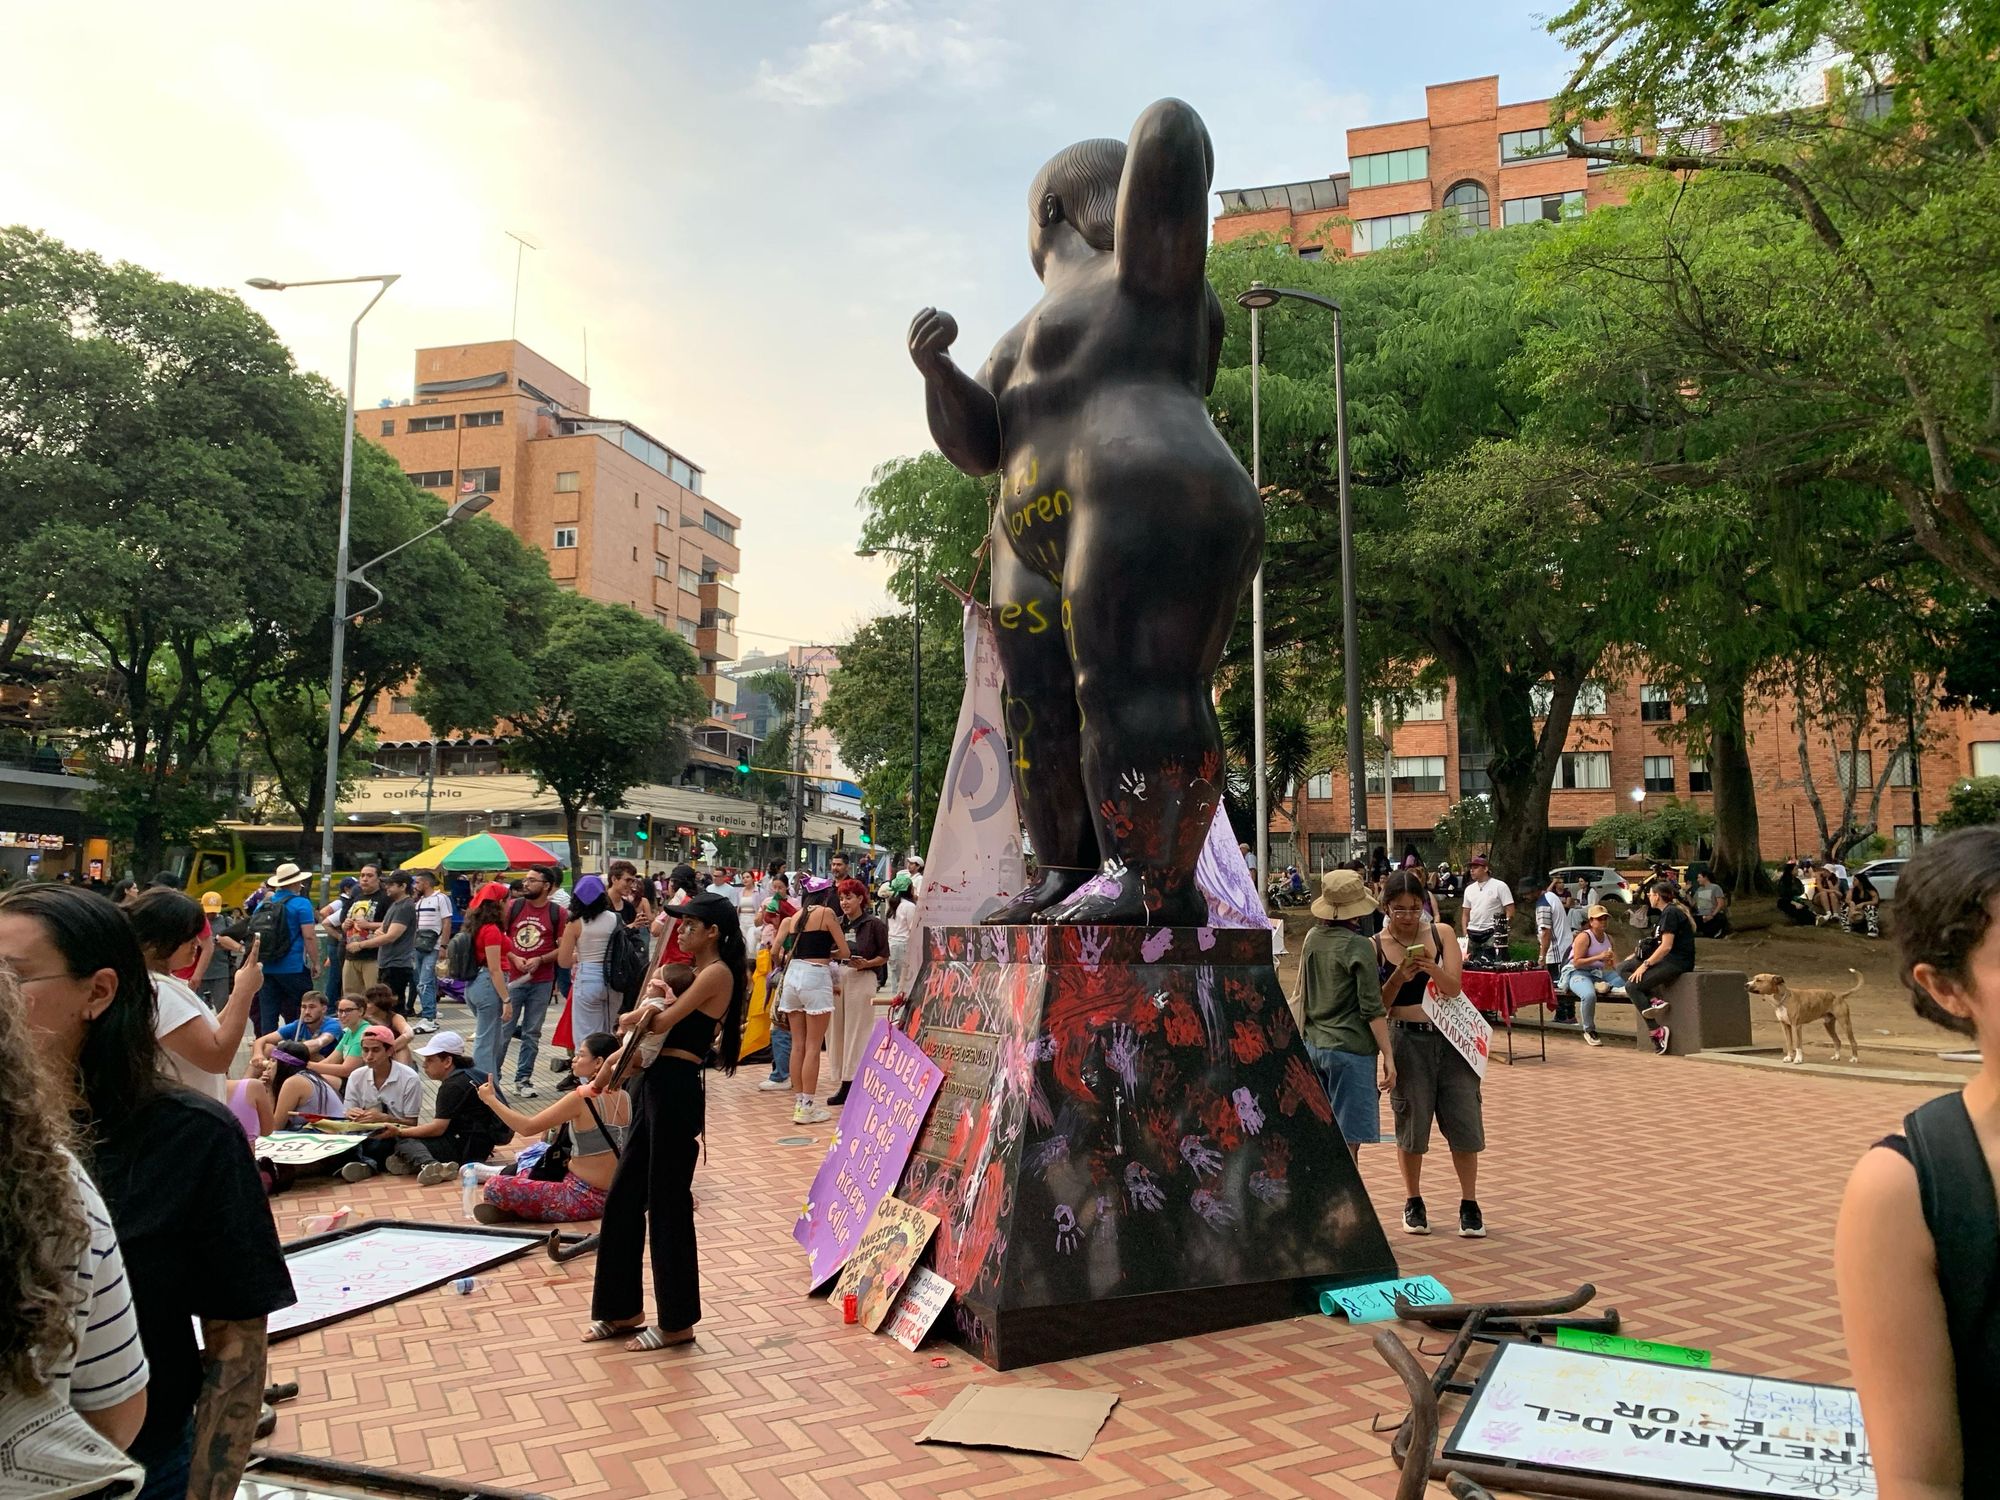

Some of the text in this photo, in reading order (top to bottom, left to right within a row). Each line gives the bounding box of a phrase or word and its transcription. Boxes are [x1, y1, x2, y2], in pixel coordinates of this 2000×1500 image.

[1432, 1004, 1478, 1065] VIOLADORES
[873, 1035, 930, 1101] ABUELA
[863, 1066, 887, 1104] Vine
[887, 1098, 919, 1136] gritar
[863, 1104, 896, 1154] lo que
[836, 1158, 867, 1224] hicieron
[921, 1275, 945, 1297] alguien
